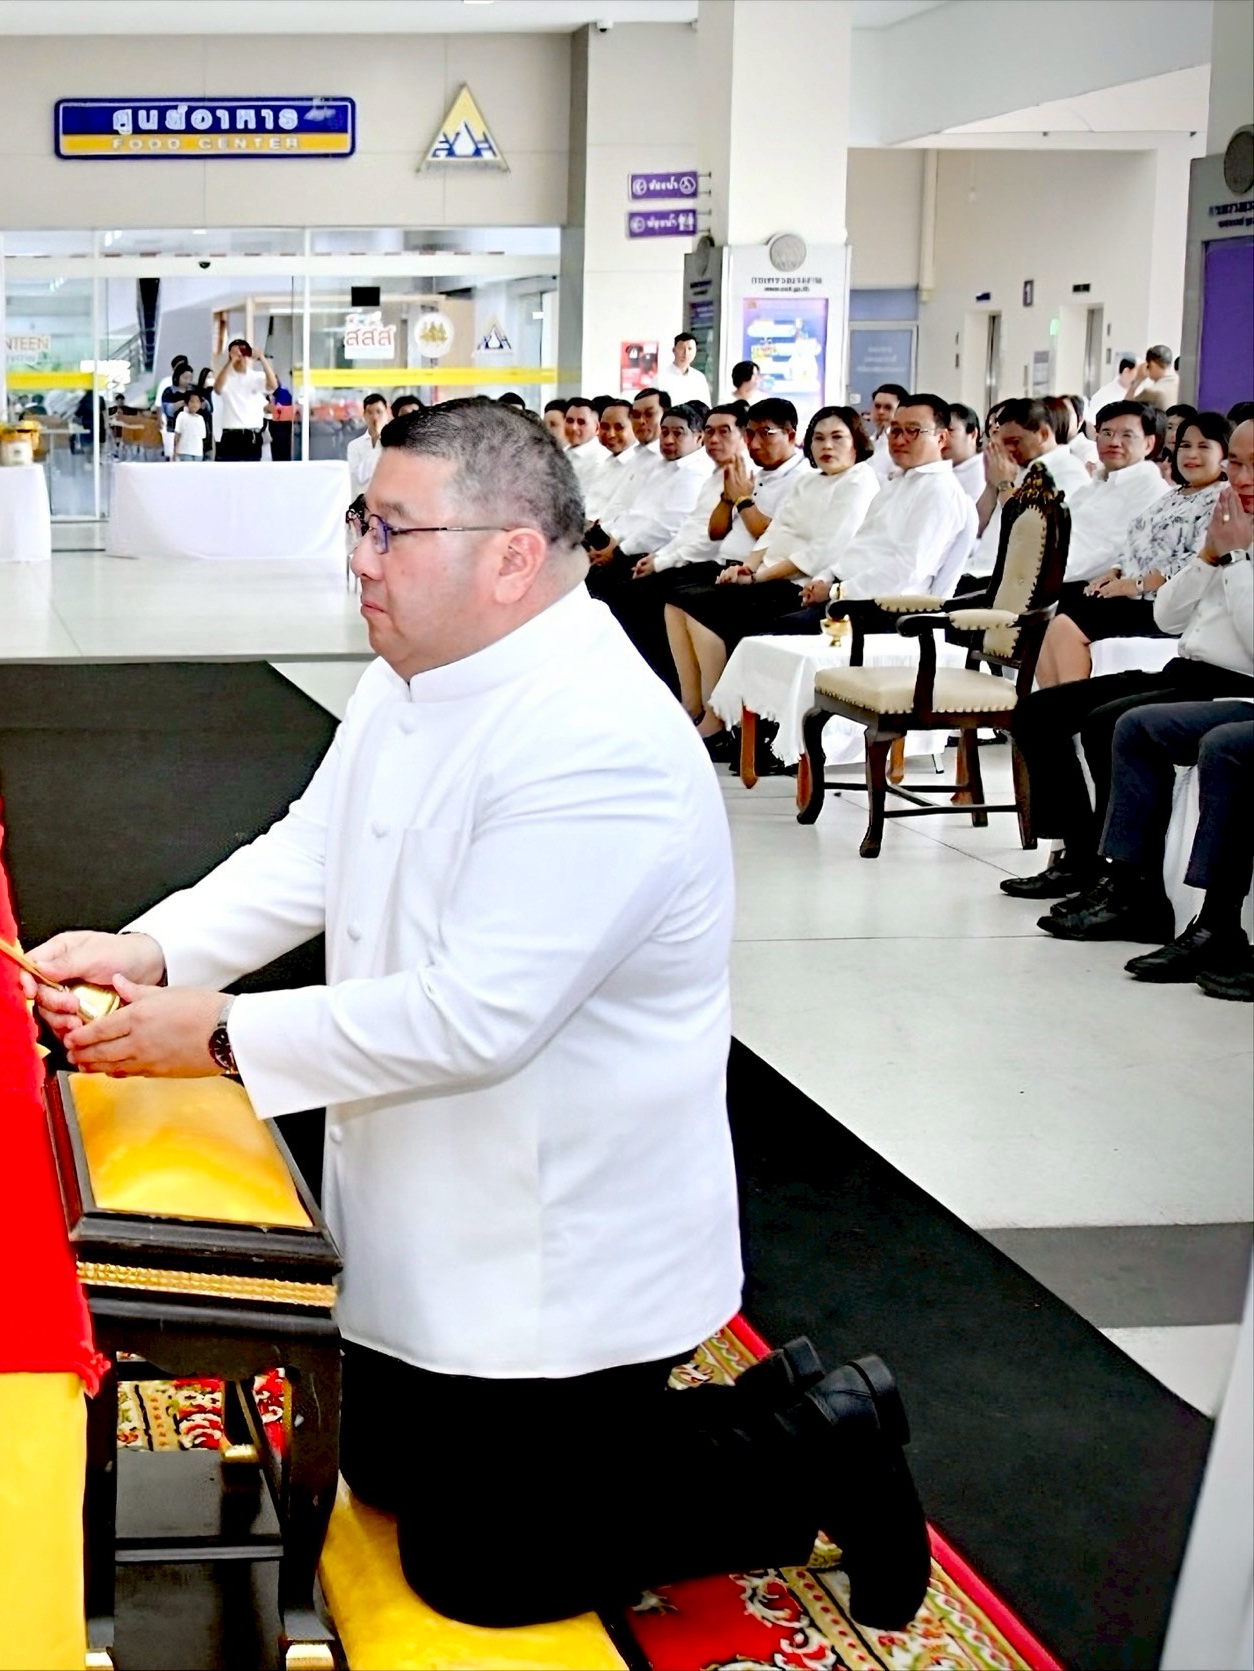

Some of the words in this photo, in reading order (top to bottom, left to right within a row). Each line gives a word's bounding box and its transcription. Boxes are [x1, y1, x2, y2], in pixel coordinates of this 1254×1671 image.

[112, 103, 299, 135] ศูนย์อาหาร
[112, 137, 181, 150] FOOD
[198, 137, 300, 150] CENTER
